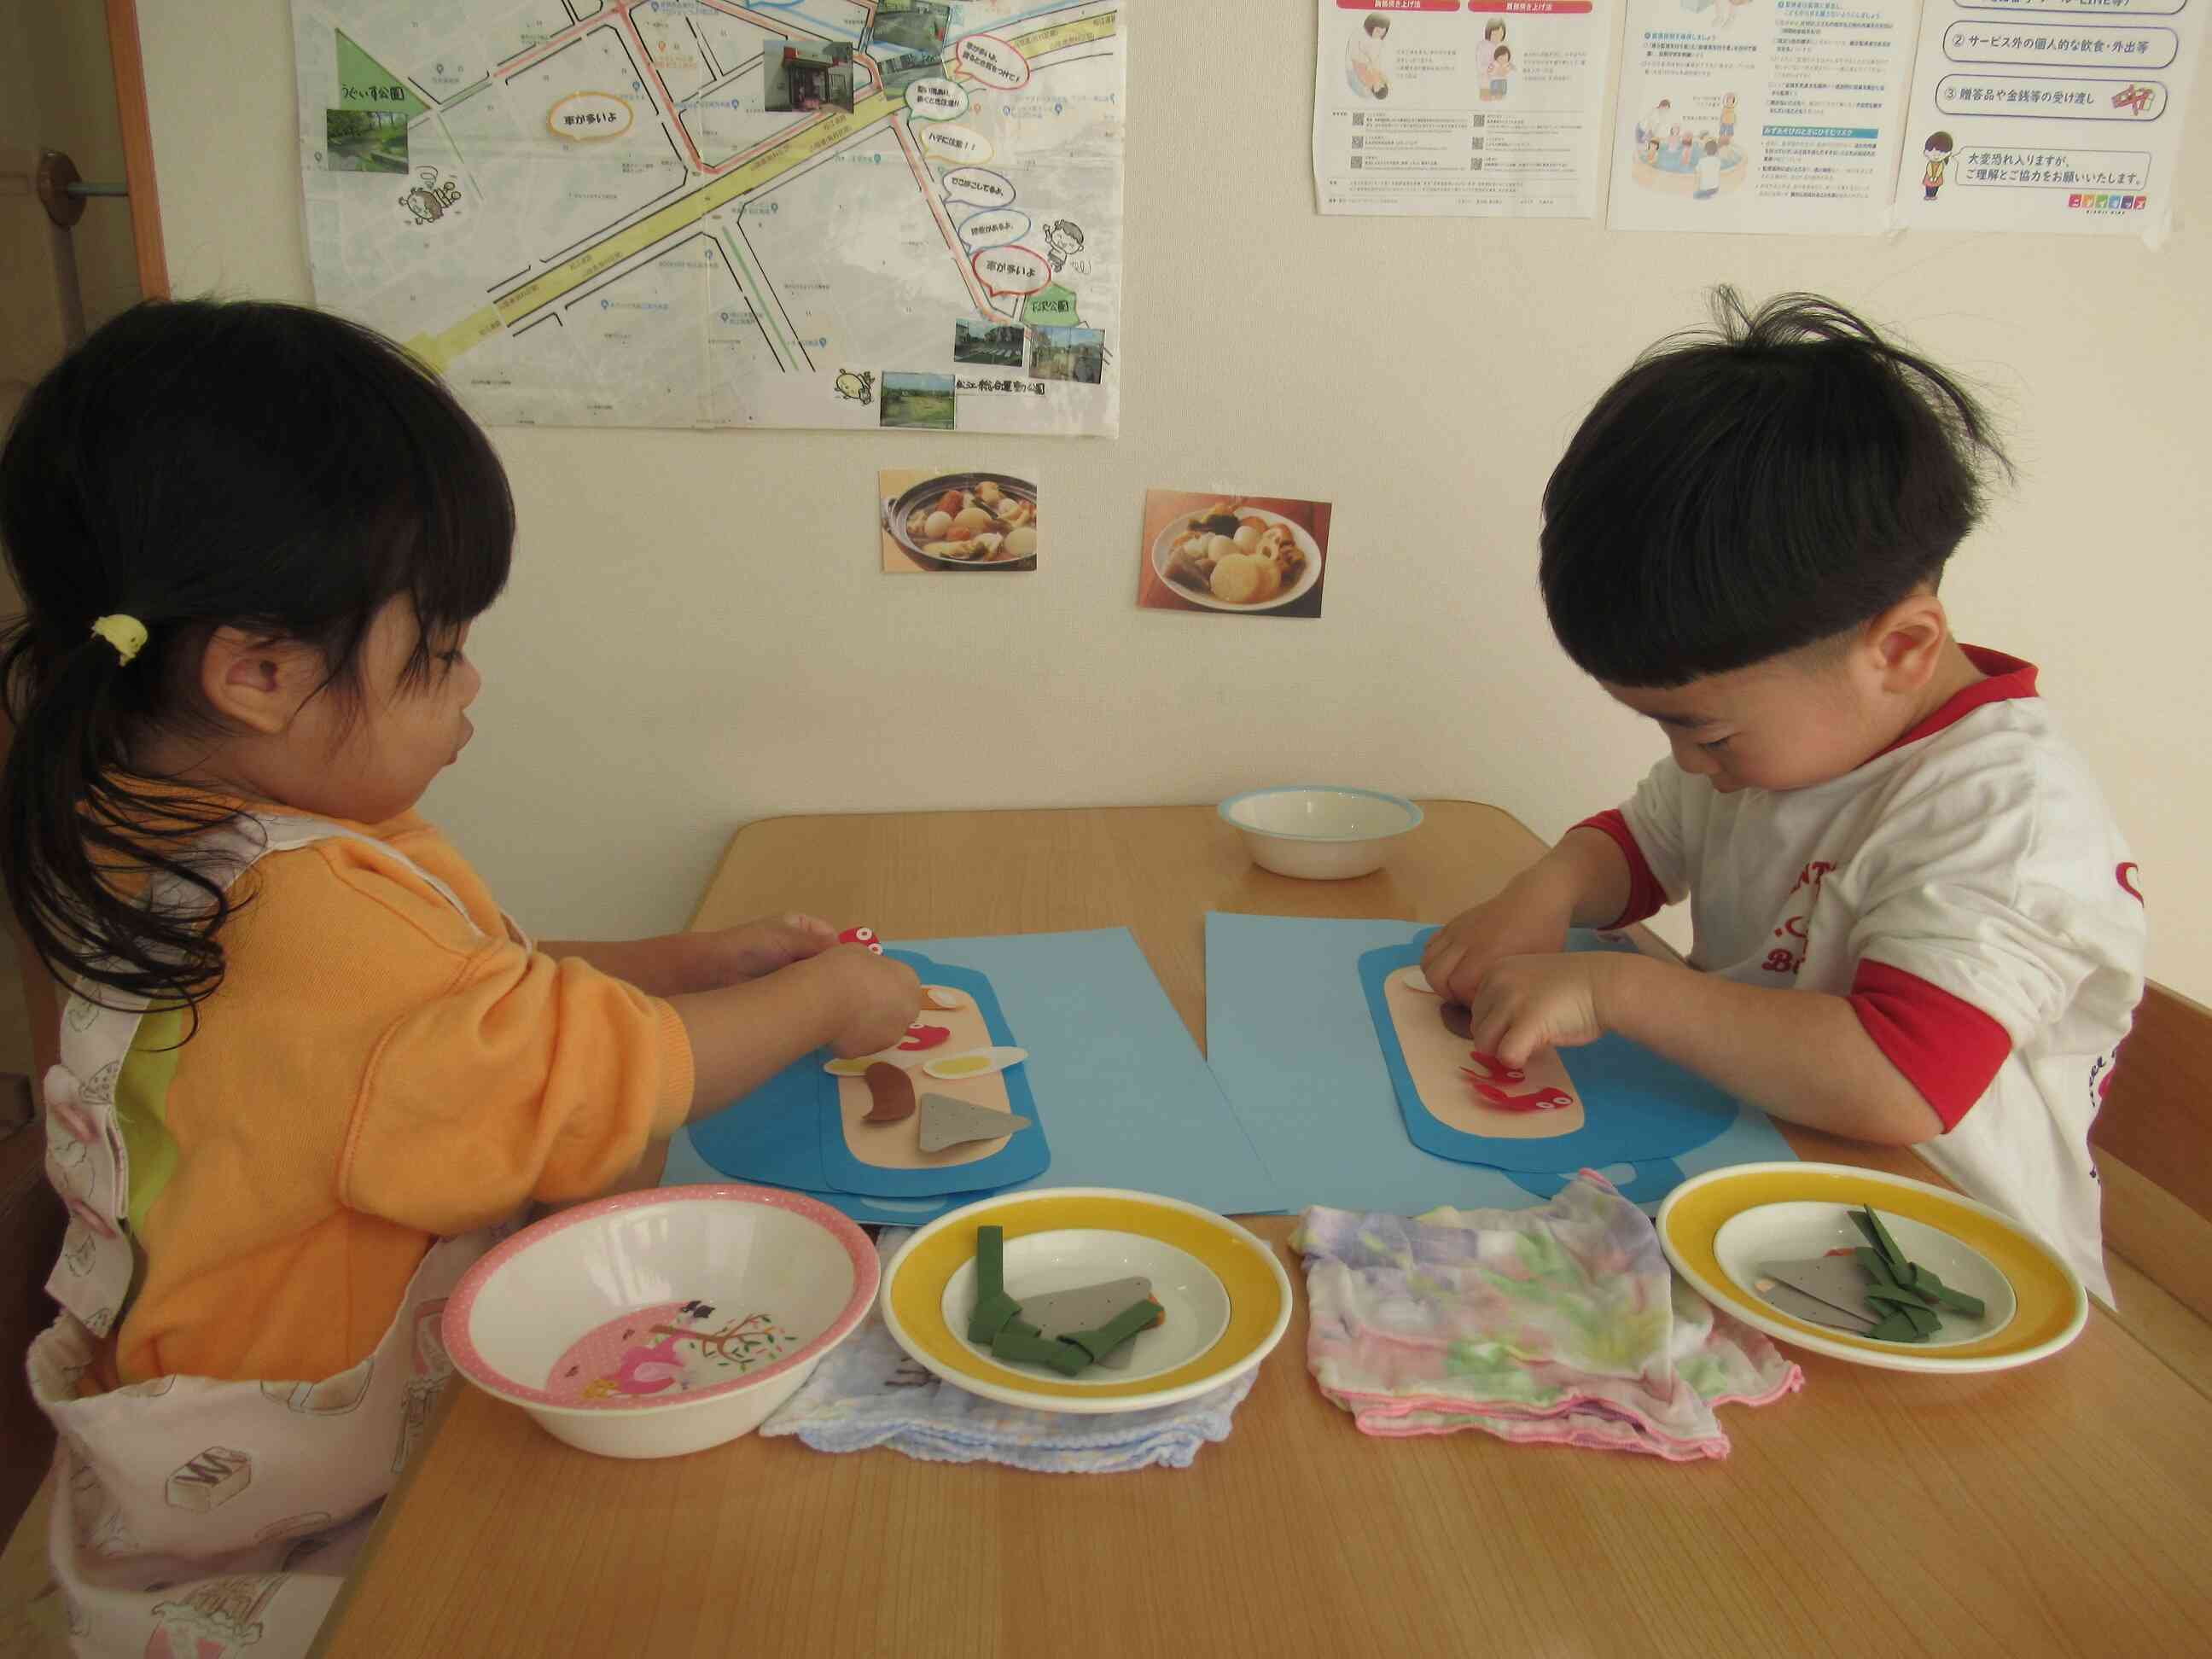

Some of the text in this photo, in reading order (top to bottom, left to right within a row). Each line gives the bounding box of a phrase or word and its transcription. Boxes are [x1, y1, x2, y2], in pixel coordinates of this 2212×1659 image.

[1969, 35, 2149, 53] サービス外の個人的な飲食・外出等
[1959, 88, 2094, 105] 贈答品や金銭等の受け渡し
[563, 112, 616, 125] 車が多いよ
[1968, 153, 2069, 167] 大変恐れ入りますが、
[1966, 169, 2141, 185] ご理解とご協力をお願いいたします。
[987, 260, 1035, 276] 車が多いよ
